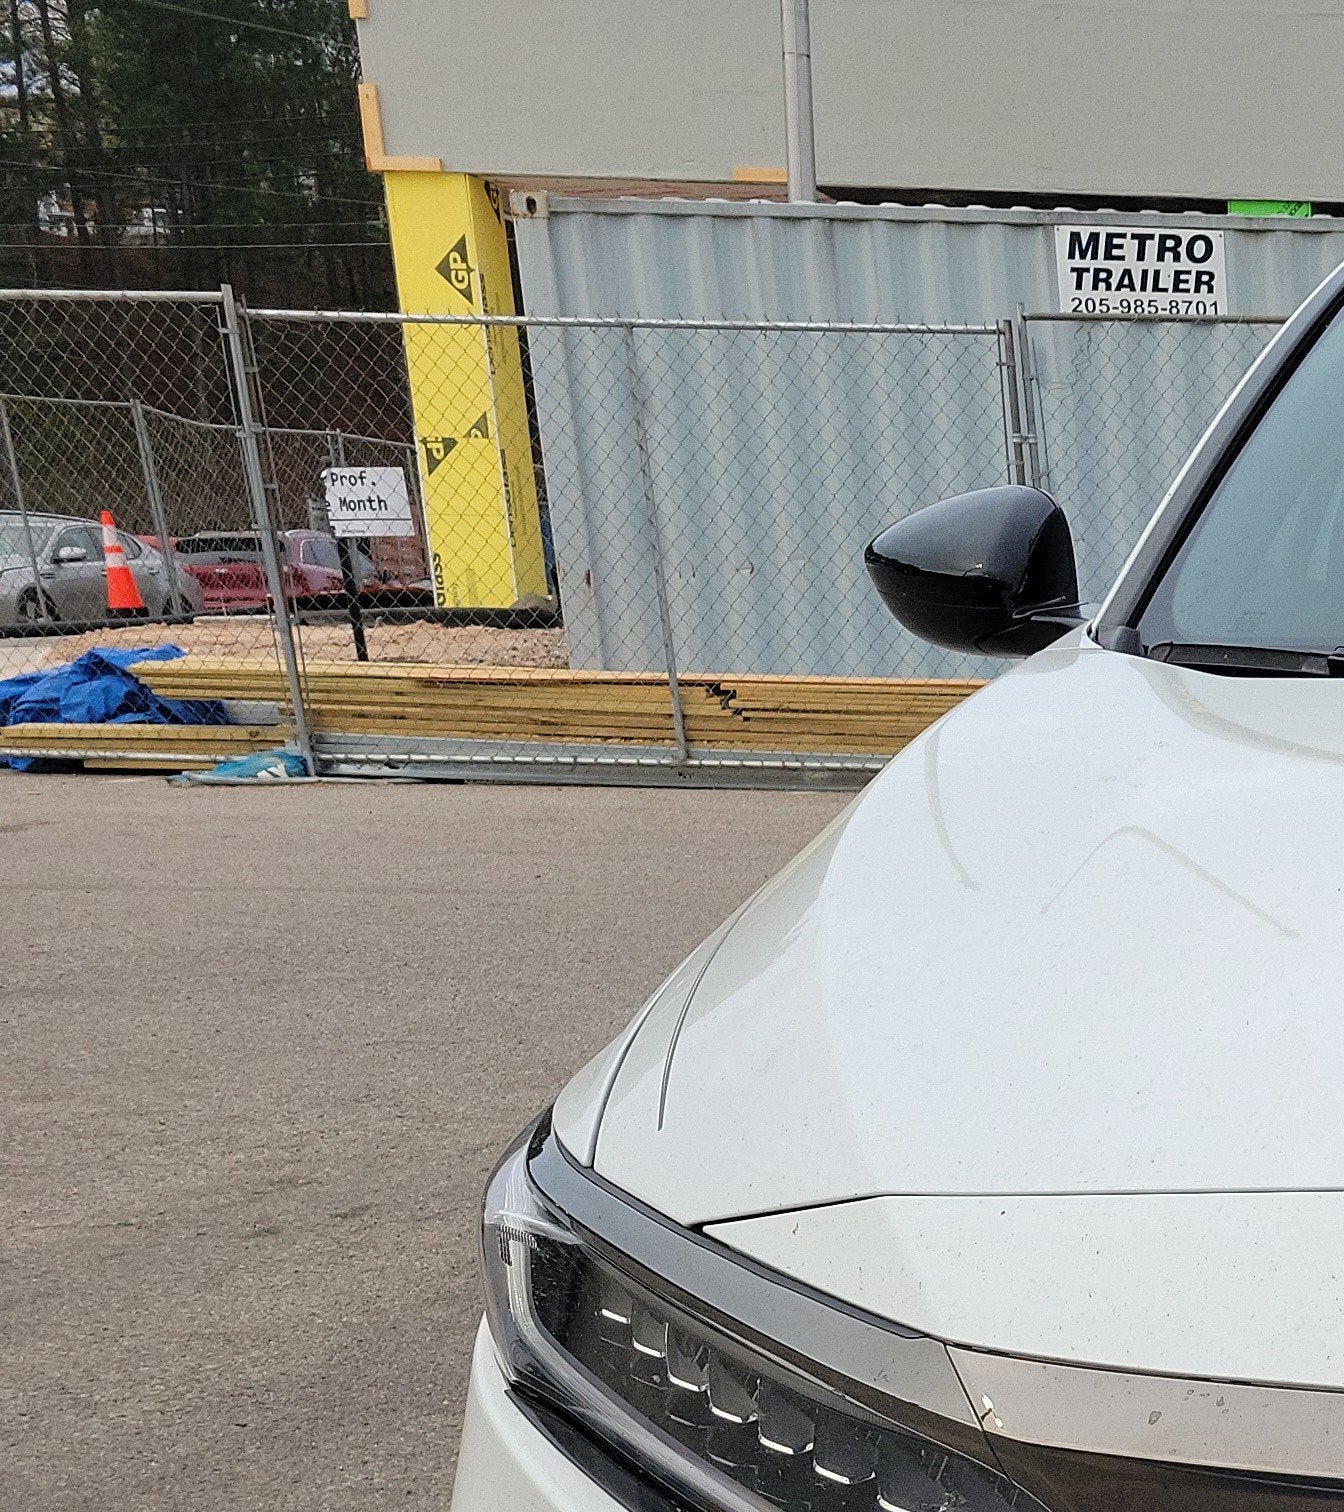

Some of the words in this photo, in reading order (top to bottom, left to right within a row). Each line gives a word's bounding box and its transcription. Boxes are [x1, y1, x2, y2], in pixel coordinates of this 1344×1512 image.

[1067, 231, 1214, 264] METRO
[449, 250, 469, 290] GP
[1070, 267, 1216, 294] TRAILER
[1070, 297, 1219, 316] 205-985-8701
[330, 470, 377, 487] Prof.
[339, 495, 389, 512] Month
